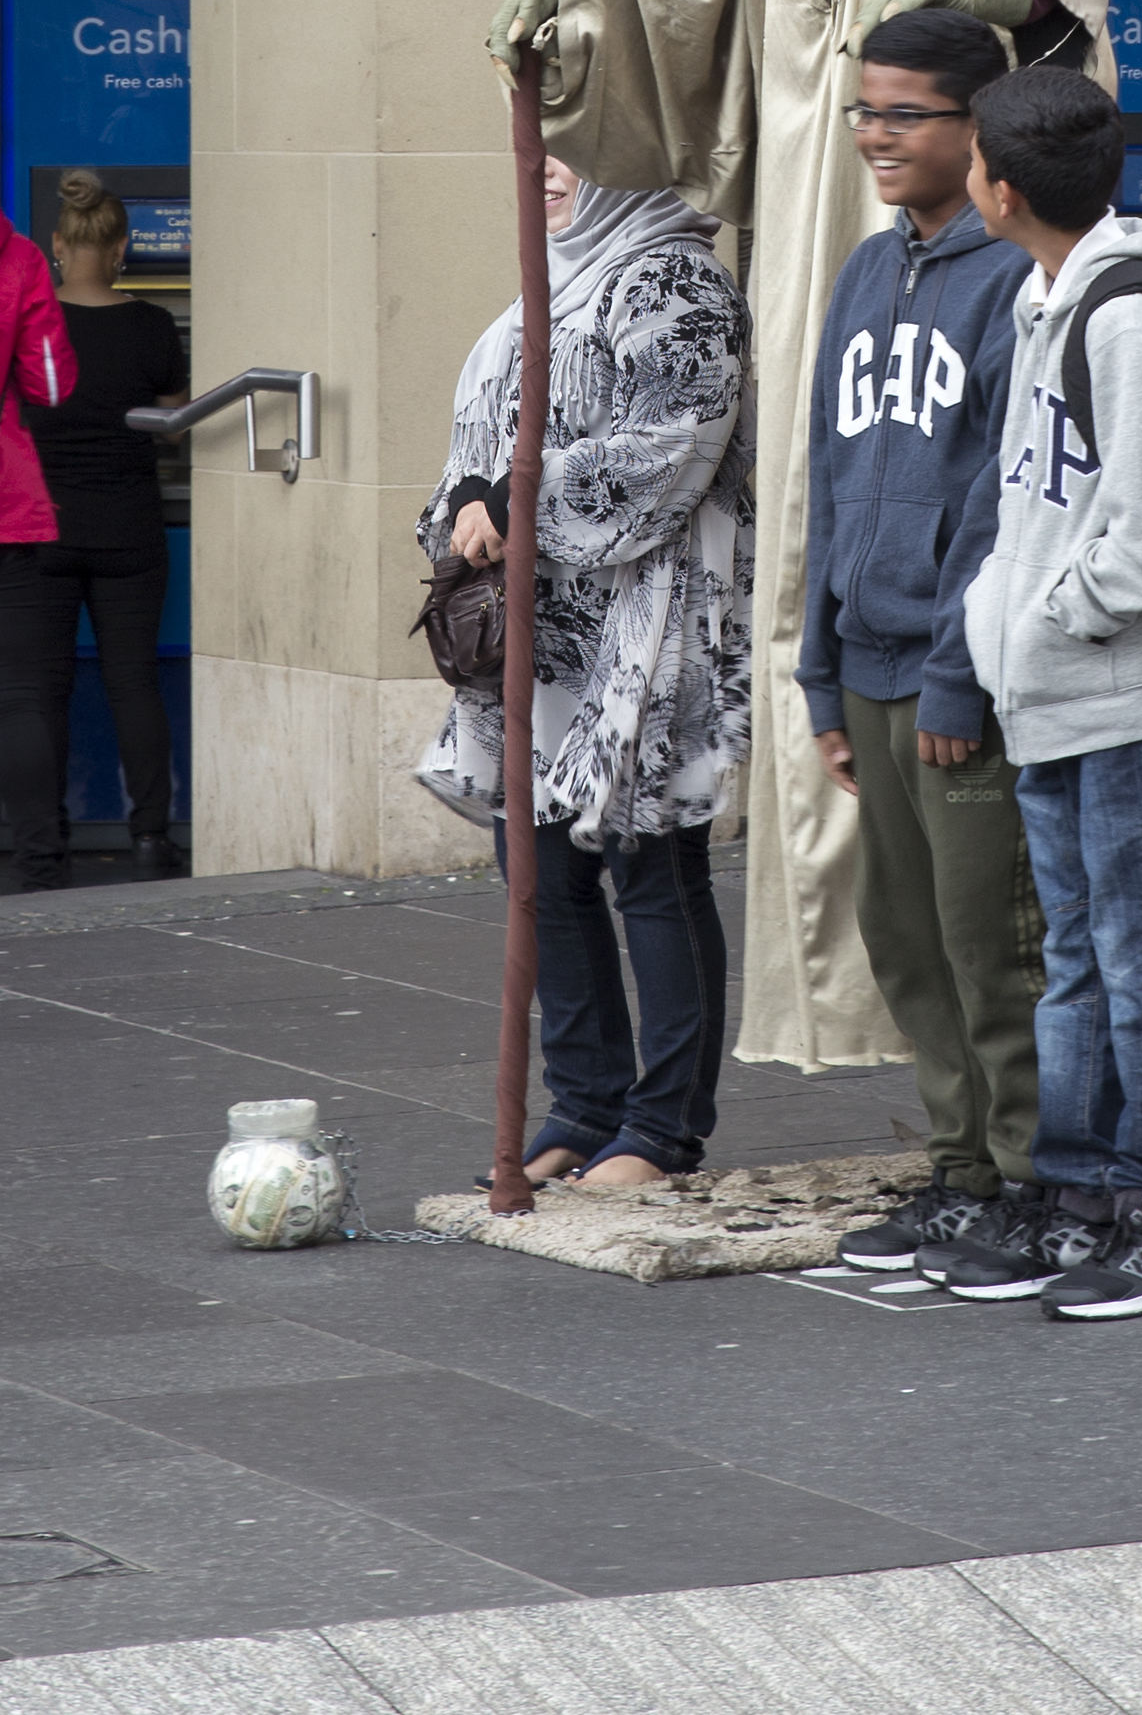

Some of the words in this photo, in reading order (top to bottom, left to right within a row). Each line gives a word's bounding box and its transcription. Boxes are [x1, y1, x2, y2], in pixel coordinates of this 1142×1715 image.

[73, 15, 191, 67] Cash
[104, 74, 141, 89] Free
[146, 73, 183, 89] cash
[836, 322, 967, 439] GAP
[946, 787, 1003, 803] adidas
